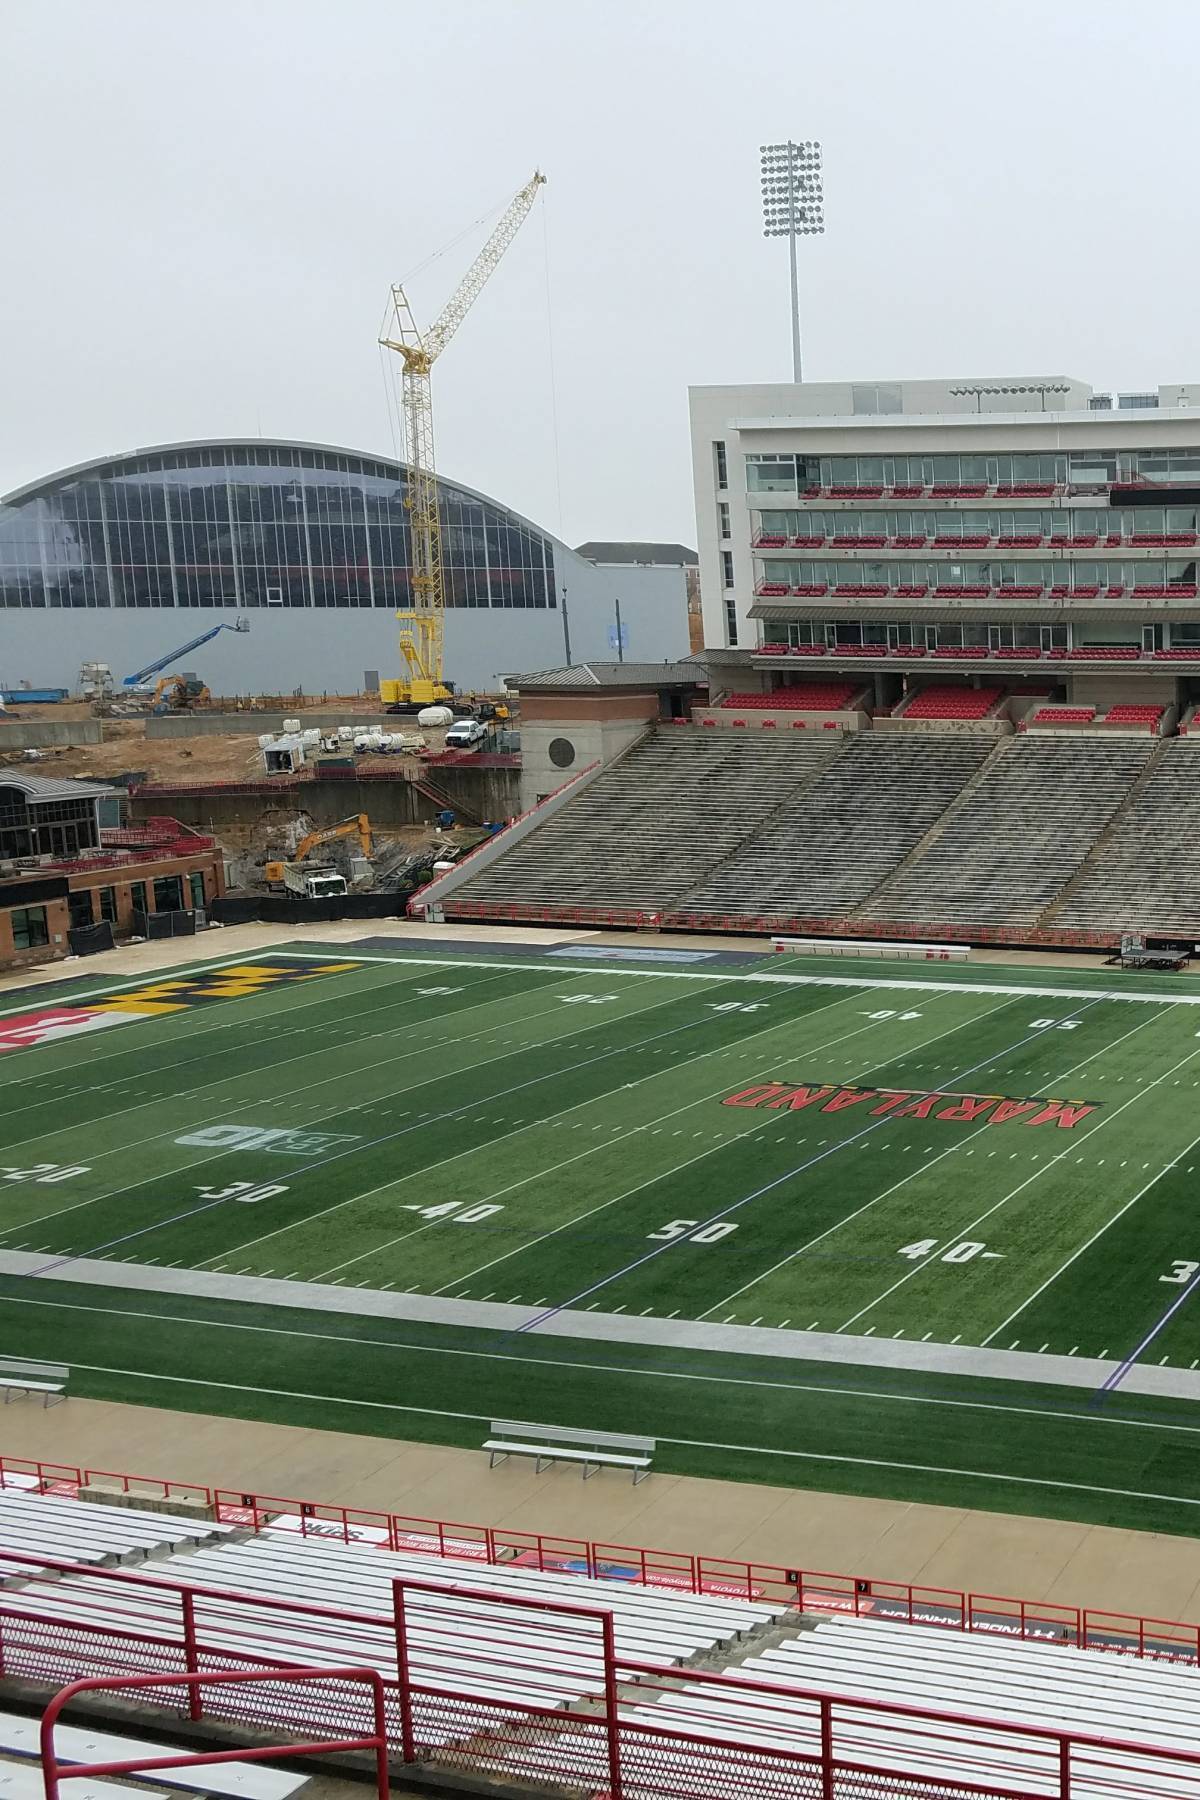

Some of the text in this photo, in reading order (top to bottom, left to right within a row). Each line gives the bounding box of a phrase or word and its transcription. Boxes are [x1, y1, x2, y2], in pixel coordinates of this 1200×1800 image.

[868, 1010, 924, 1021] 40
[1028, 1018, 1083, 1030] 50
[720, 1084, 1098, 1128] MARYLAND
[2, 1163, 93, 1183] 20
[198, 1182, 291, 1203] 30
[416, 1201, 505, 1223] 40
[645, 1219, 740, 1243] 50
[897, 1239, 987, 1264] 40
[710, 1584, 746, 1595] TOYOTA
